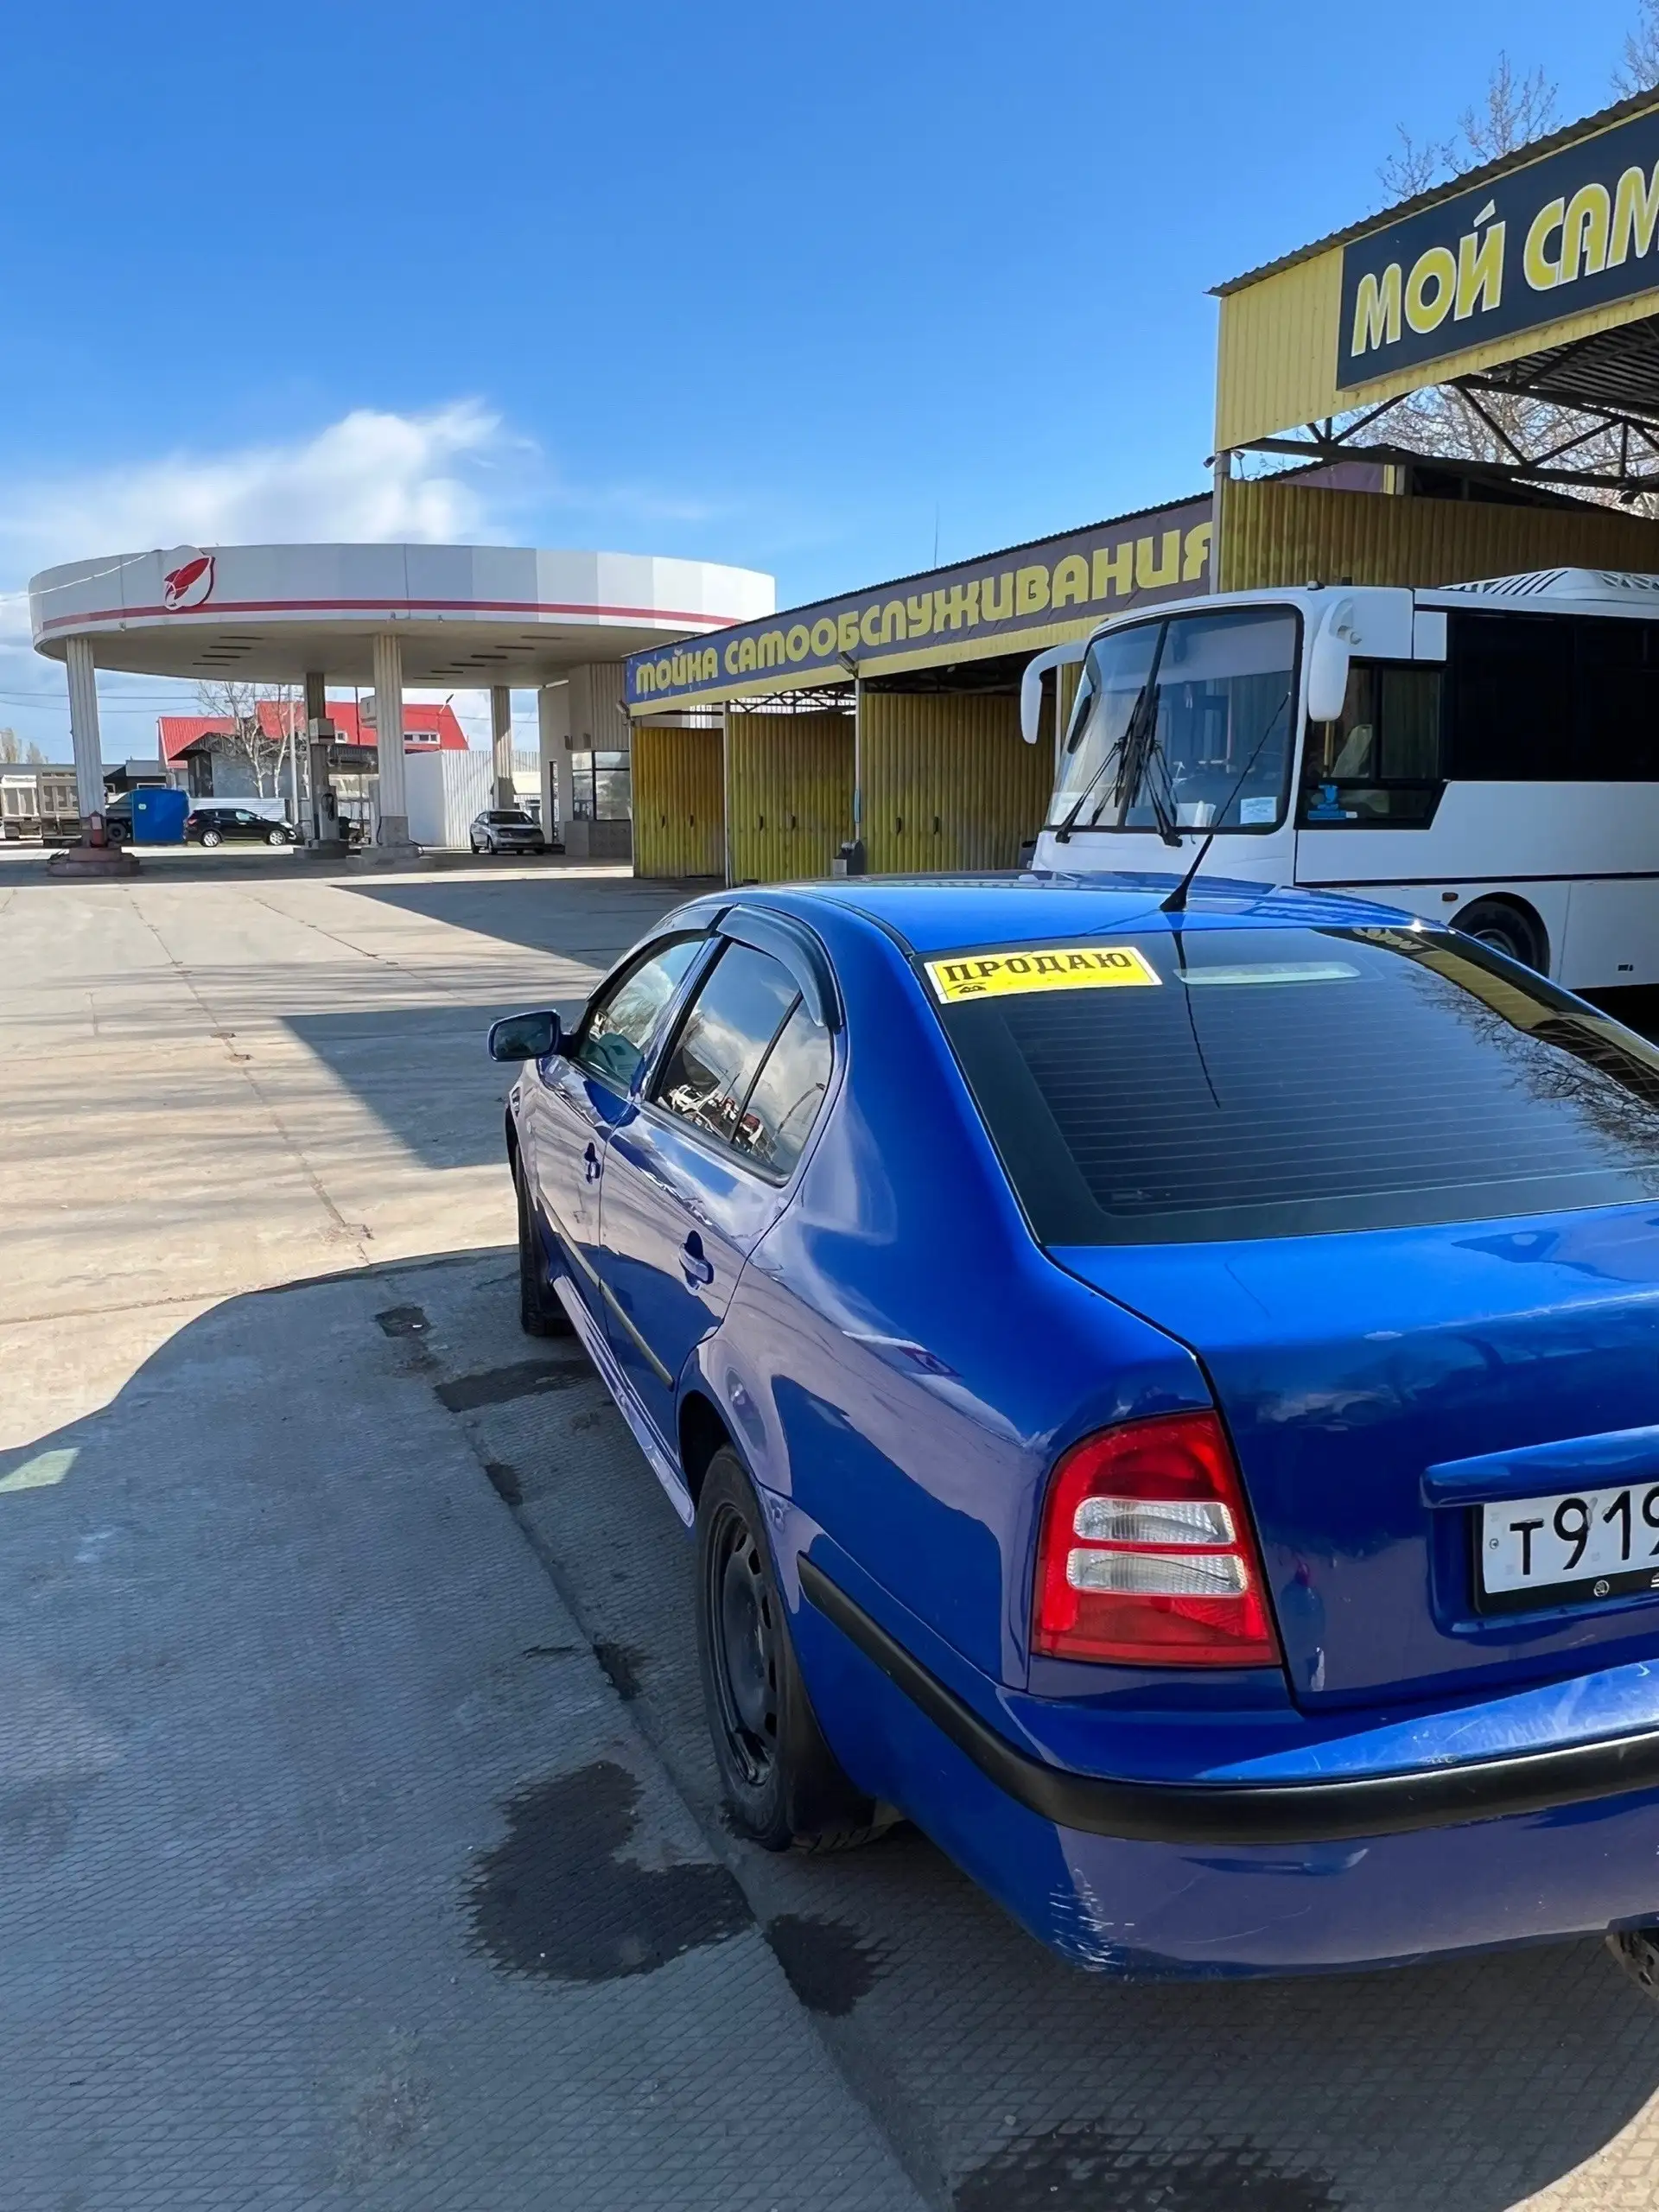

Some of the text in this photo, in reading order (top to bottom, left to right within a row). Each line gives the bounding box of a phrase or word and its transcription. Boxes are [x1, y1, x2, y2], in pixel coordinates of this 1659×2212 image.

[1351, 158, 1659, 358] МОЙ САМ
[636, 521, 1213, 695] МОЙКА САМООБСЛУЖИВАНИЯ
[943, 952, 1133, 982] ПРОДАЮ
